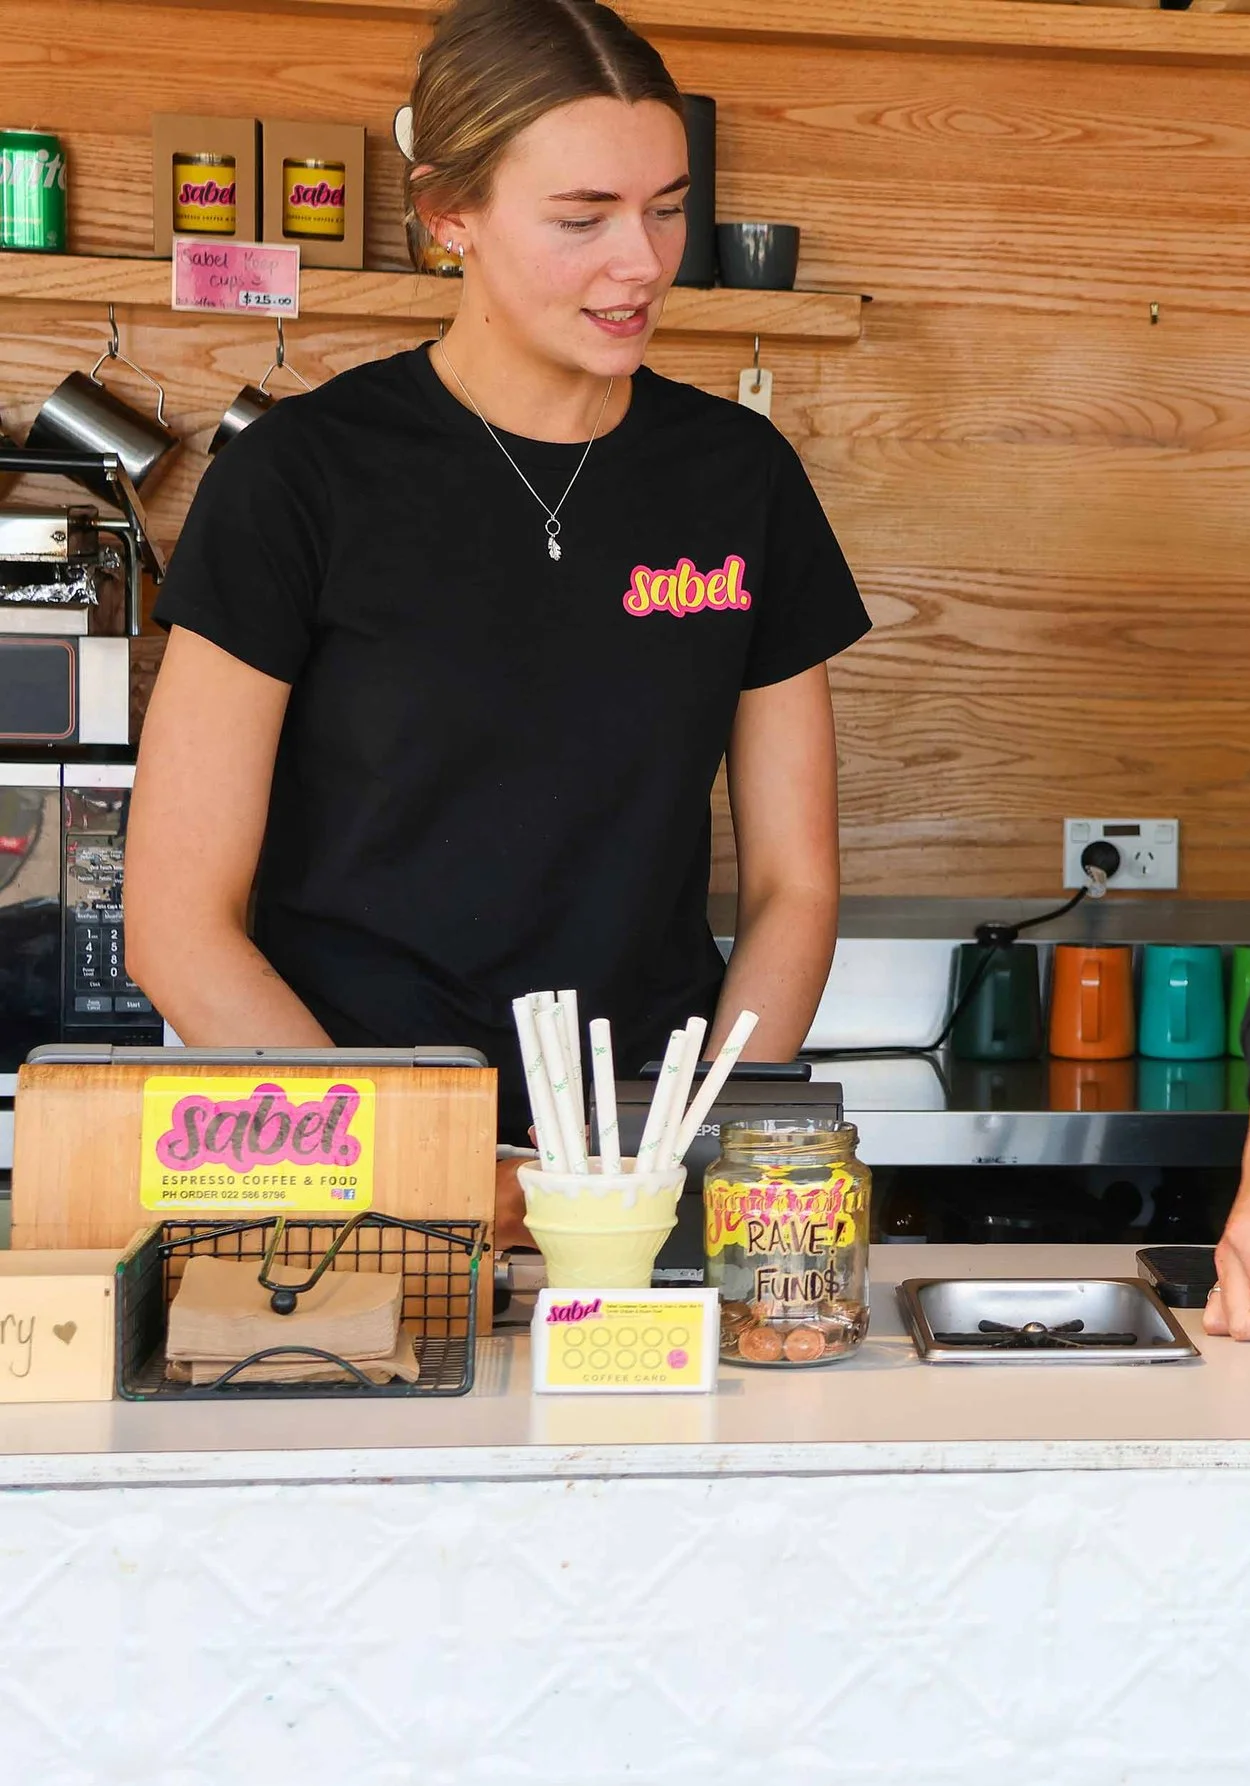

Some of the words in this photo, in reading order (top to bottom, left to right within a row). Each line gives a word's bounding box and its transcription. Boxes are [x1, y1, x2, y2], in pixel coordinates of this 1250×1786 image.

[110, 929, 118, 940] 2
[85, 942, 93, 952] 4
[110, 942, 118, 952] 5
[86, 954, 93, 965] 7
[110, 954, 118, 965] 8
[110, 967, 118, 977] 0
[162, 1175, 236, 1186] ESPRESSO
[242, 1175, 297, 1186] COFFEE
[303, 1175, 313, 1186] &
[320, 1175, 358, 1186] FOOD
[162, 1190, 177, 1199] PH
[179, 1190, 218, 1199] ORDER
[221, 1190, 239, 1199] 022
[262, 1190, 286, 1199] 8796
[748, 1220, 846, 1254] RAVE!
[757, 1259, 840, 1303] FUND$
[582, 1374, 629, 1382] COFFEE
[634, 1374, 667, 1382] CARD
